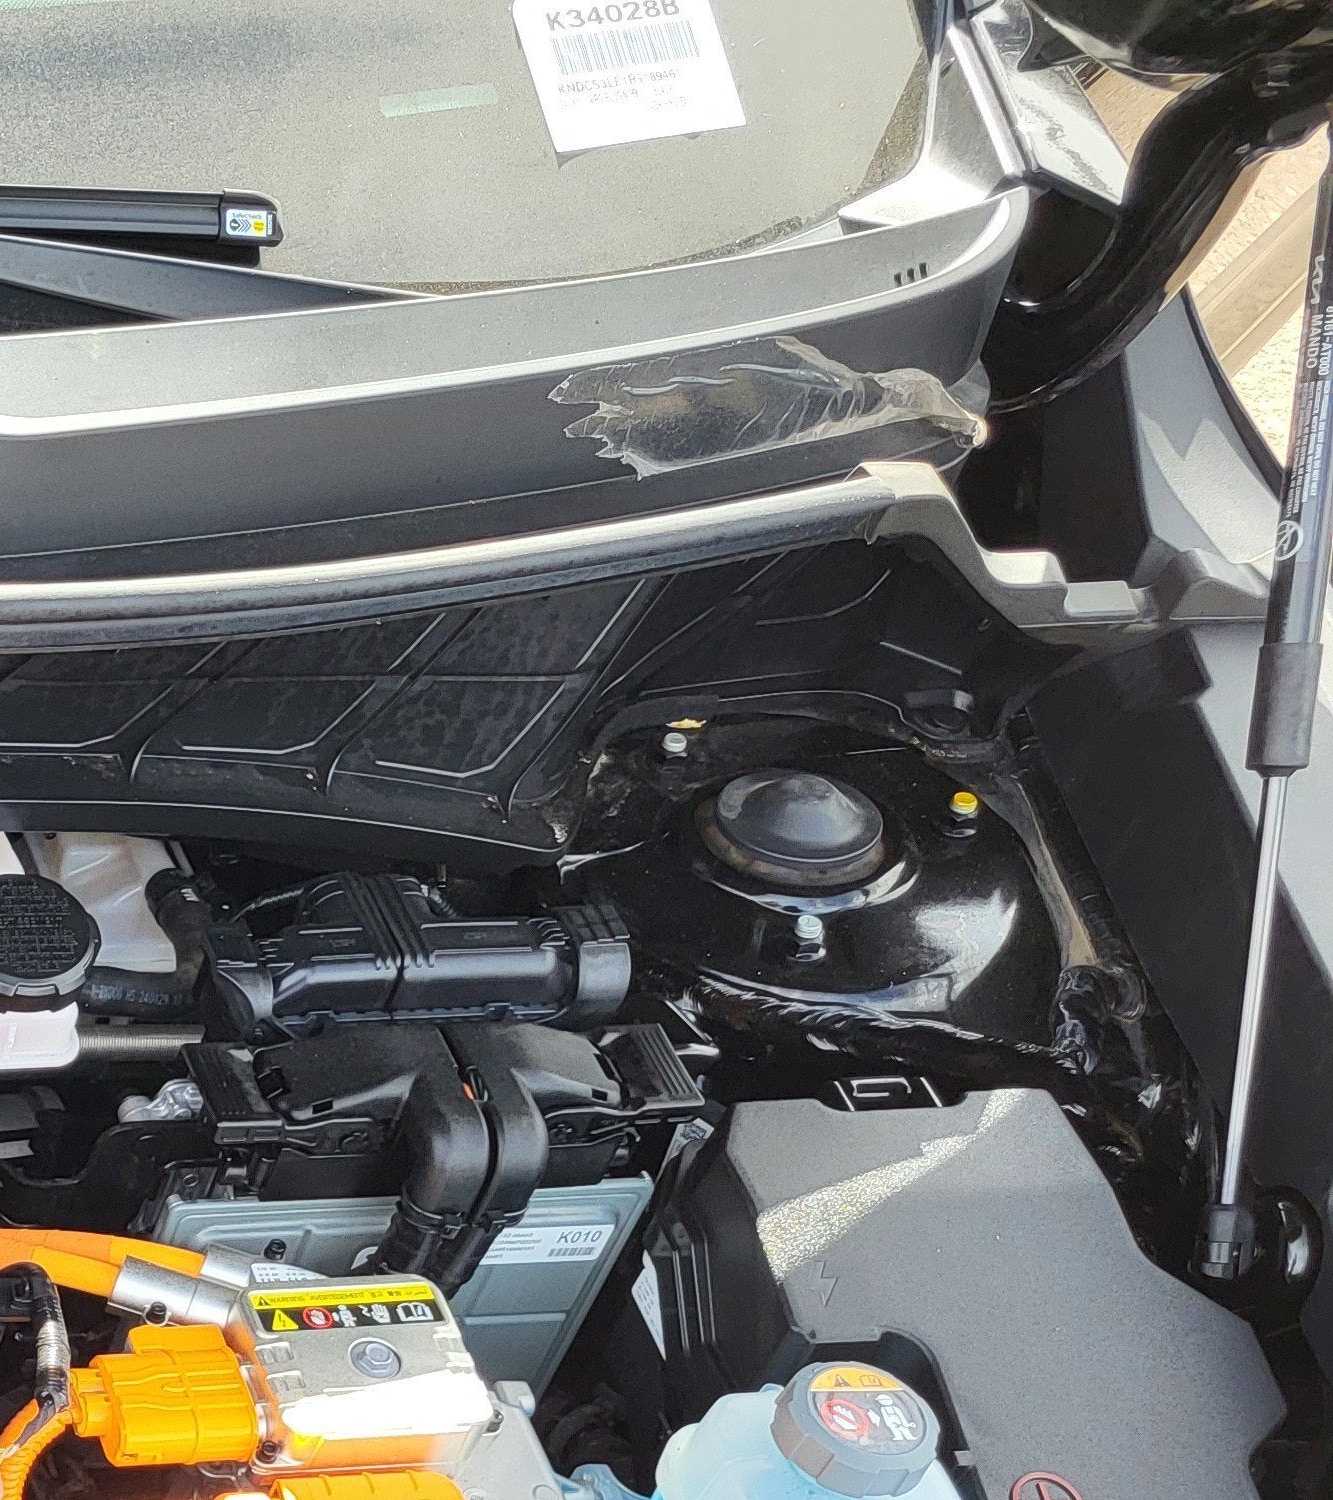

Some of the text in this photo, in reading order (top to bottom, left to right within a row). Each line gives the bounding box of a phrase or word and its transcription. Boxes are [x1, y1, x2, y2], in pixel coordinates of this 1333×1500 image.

[546, 0, 680, 31] K34028B
[1306, 314, 1324, 369] MANDO
[556, 1230, 603, 1244] K010
